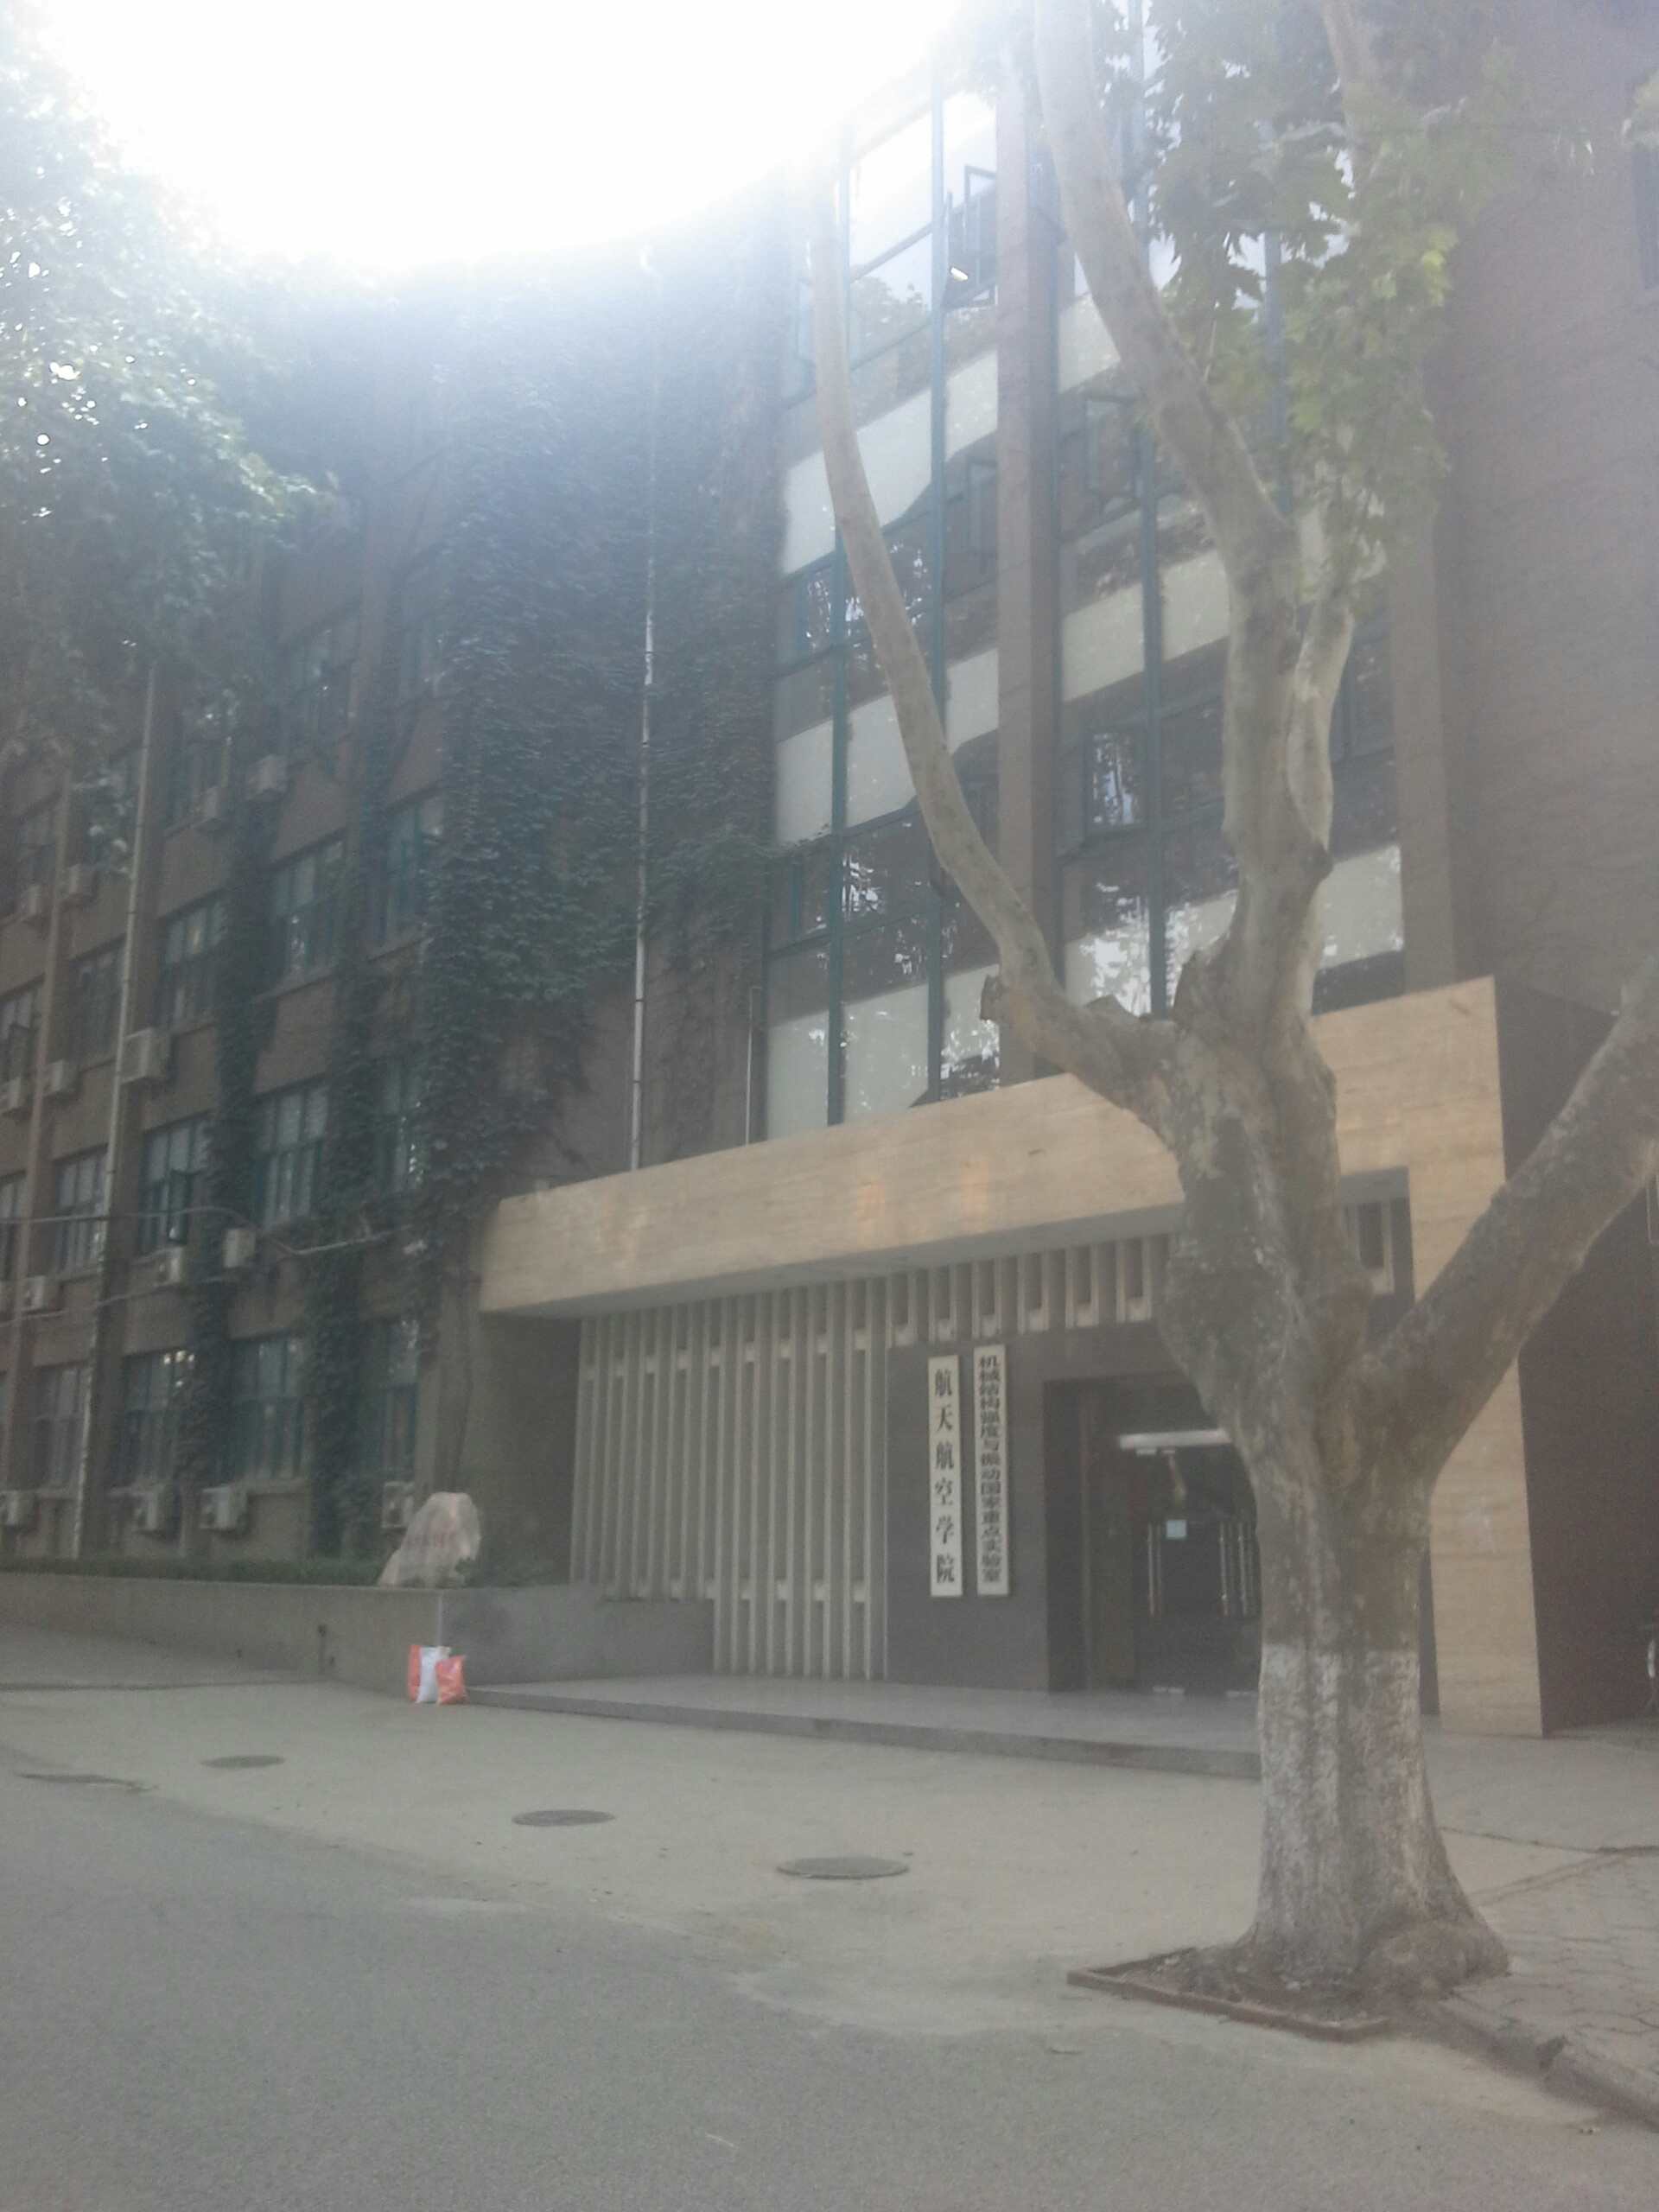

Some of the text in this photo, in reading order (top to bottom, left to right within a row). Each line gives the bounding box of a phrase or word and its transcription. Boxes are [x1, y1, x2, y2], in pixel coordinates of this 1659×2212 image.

[934, 1369, 955, 1583] 航天航空学院
